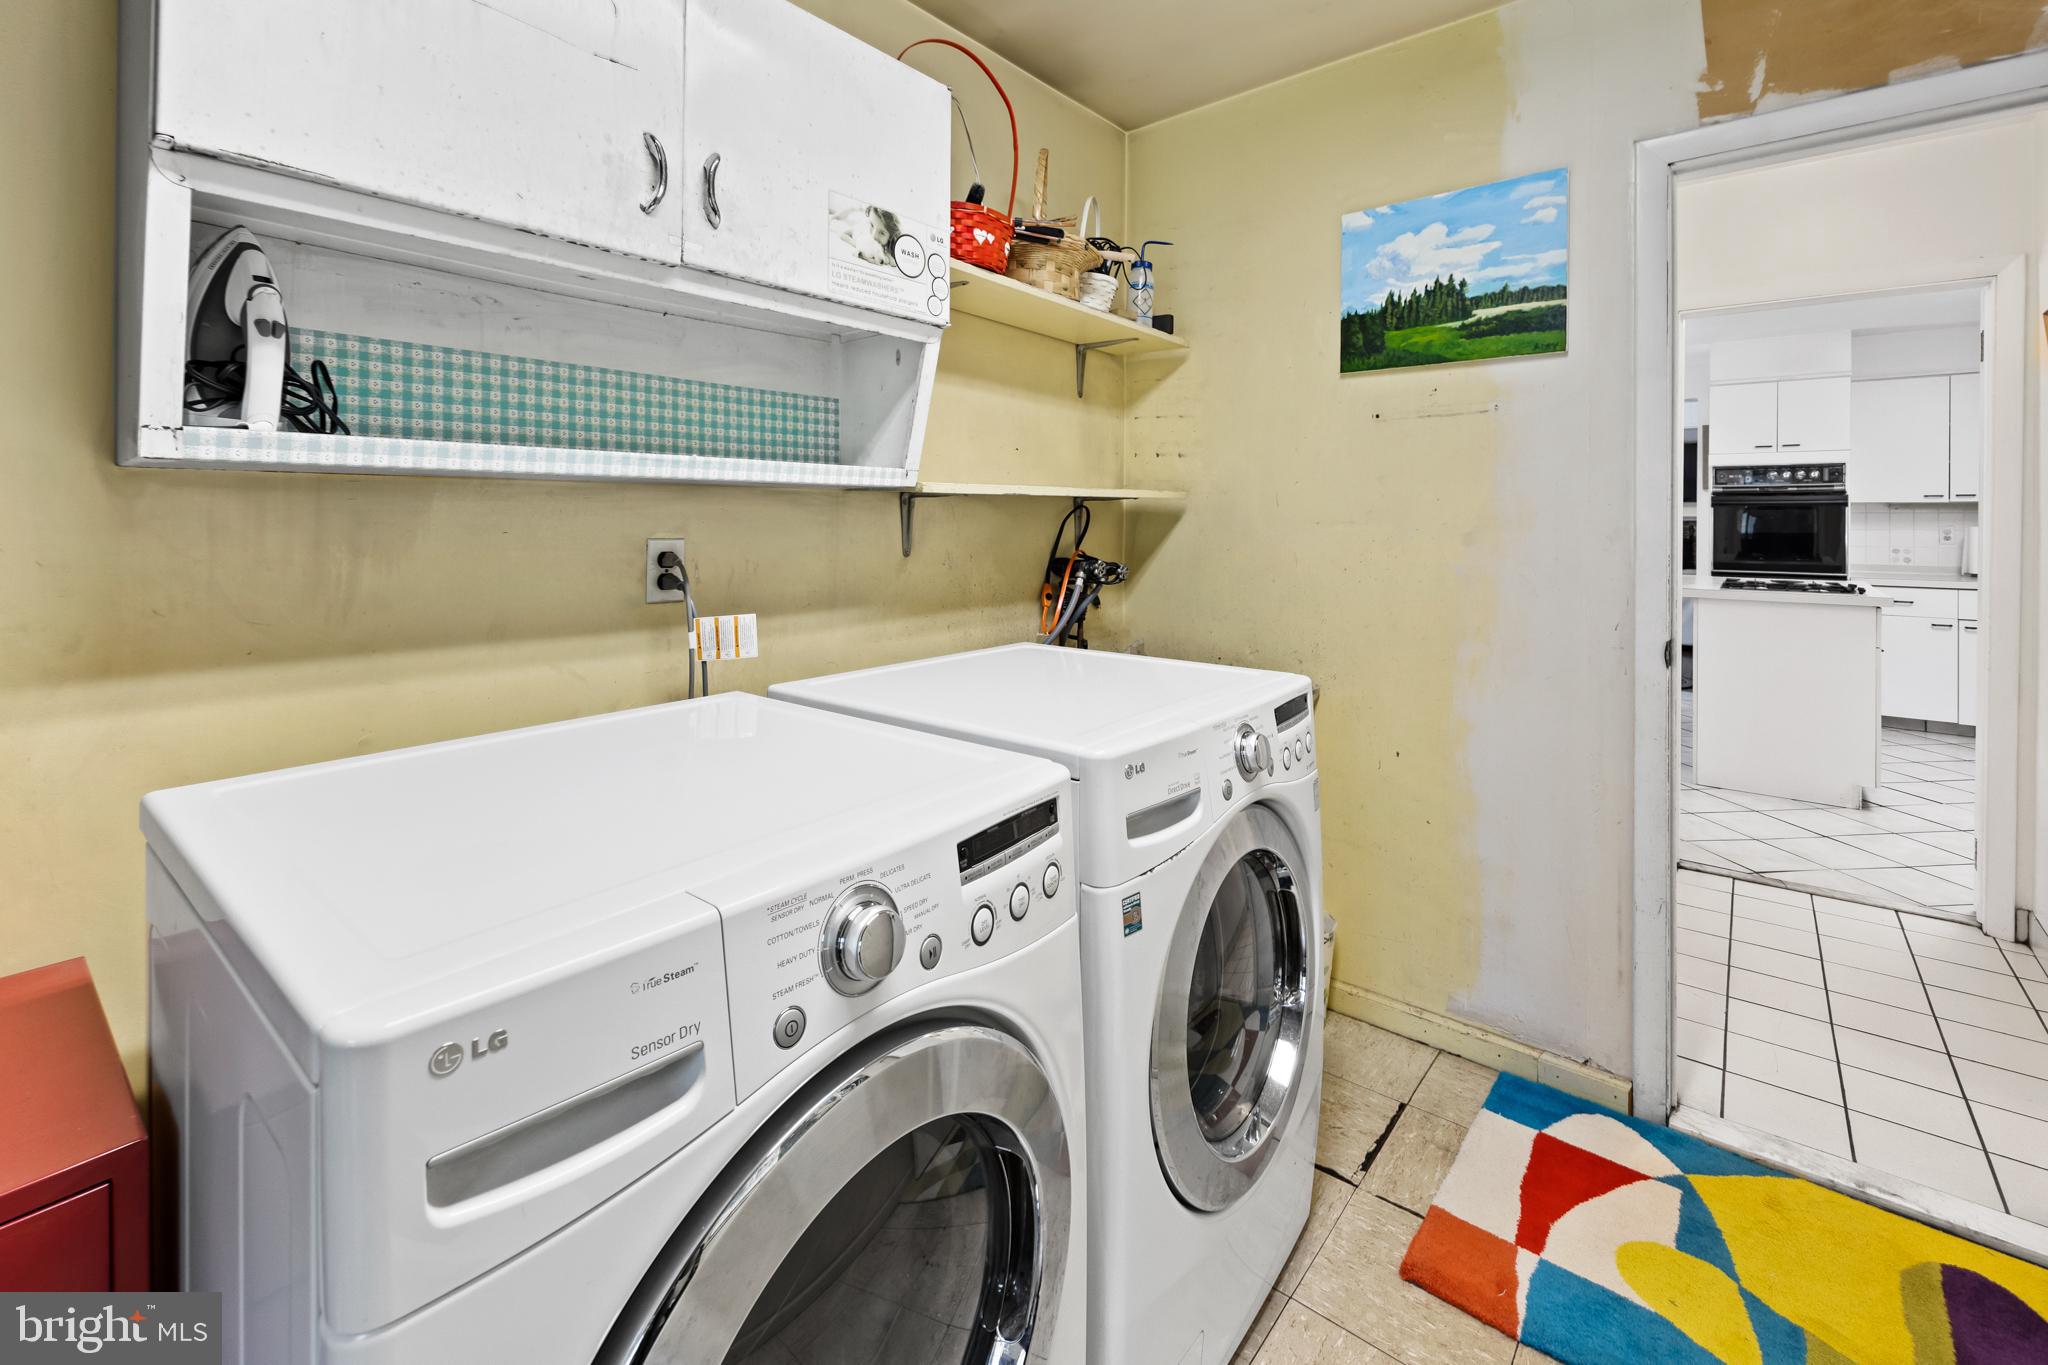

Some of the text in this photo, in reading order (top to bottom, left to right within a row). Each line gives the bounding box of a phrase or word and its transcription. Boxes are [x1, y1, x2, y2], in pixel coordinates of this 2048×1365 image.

[901, 248, 920, 259] WASH
[1134, 761, 1146, 775] LG
[856, 867, 874, 878] PRESS
[879, 864, 905, 879] DELICATES
[894, 872, 932, 894] ULTRA DELICATE
[790, 892, 808, 905] CYCLE
[809, 892, 834, 907] NORMAL
[903, 897, 929, 914] SPEED DRY
[770, 904, 805, 923] SENSOR DRY
[766, 919, 821, 946] COTTON/TOWELS
[777, 946, 816, 968] HEAVY DUTY
[772, 984, 794, 1000] STEAM
[471, 1028, 509, 1060] LG
[631, 1020, 702, 1061] Sensor Dry
